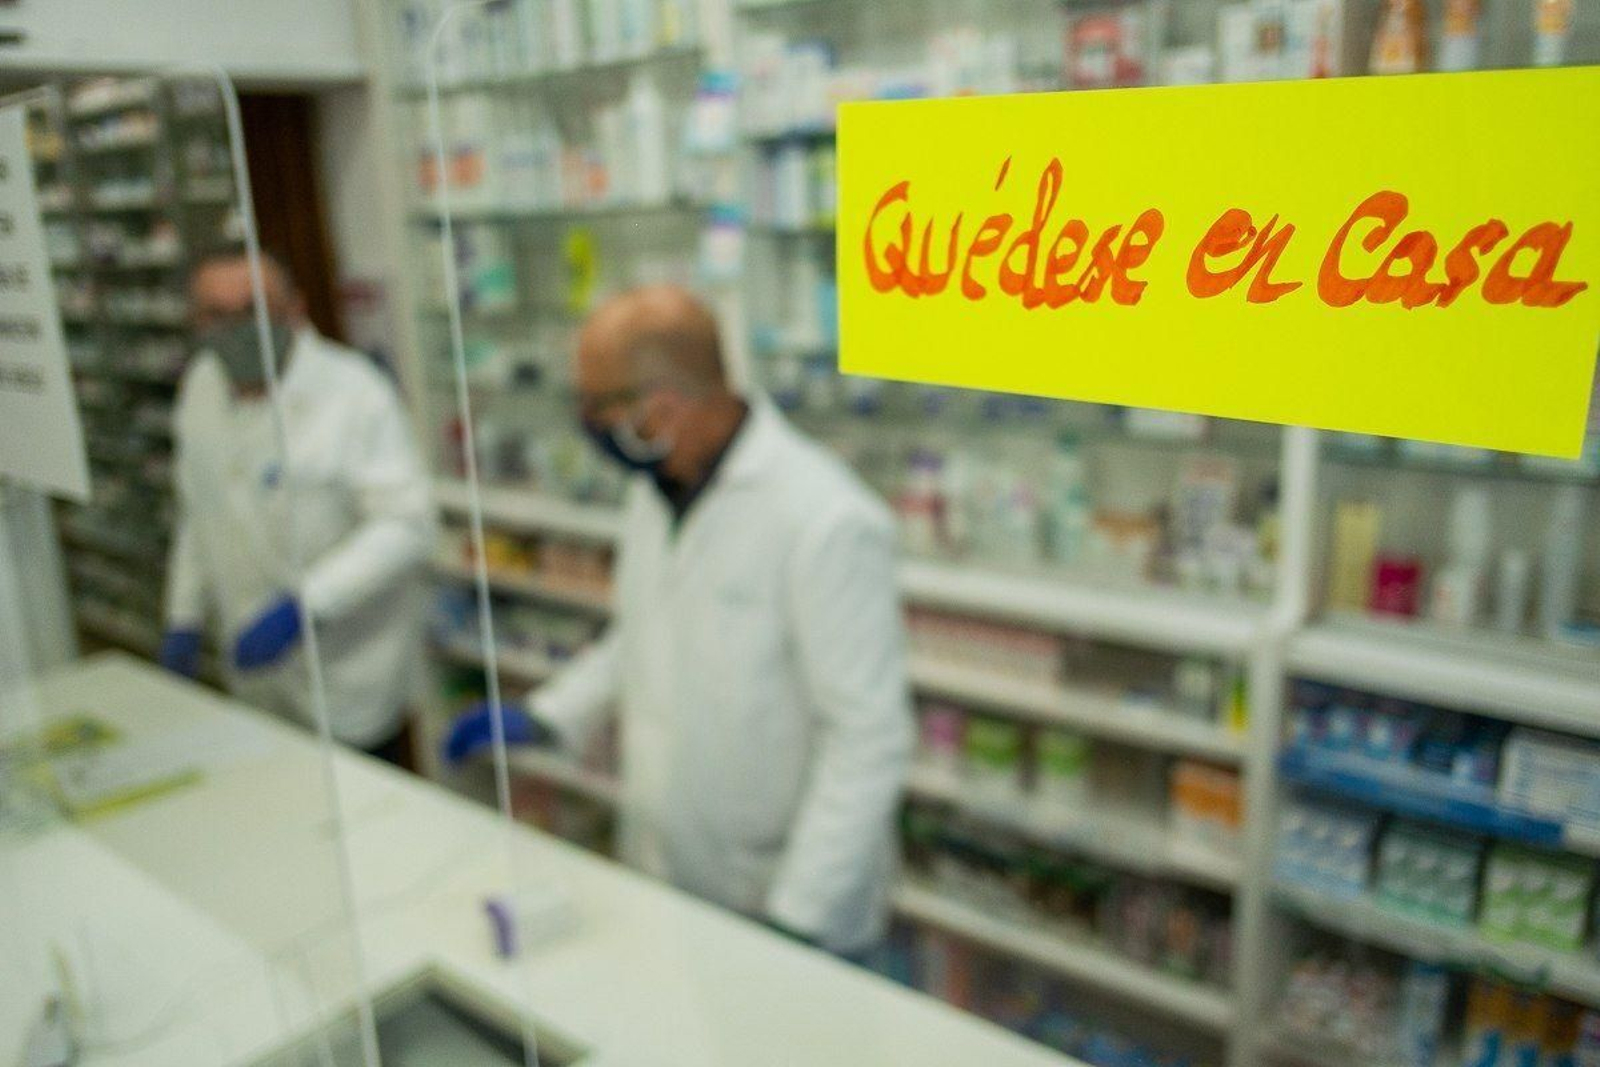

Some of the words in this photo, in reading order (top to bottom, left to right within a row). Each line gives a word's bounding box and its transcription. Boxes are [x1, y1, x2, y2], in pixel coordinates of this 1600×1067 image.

[863, 155, 1165, 310] Quédese
[1186, 208, 1303, 304] en
[1317, 190, 1588, 310] Casa
